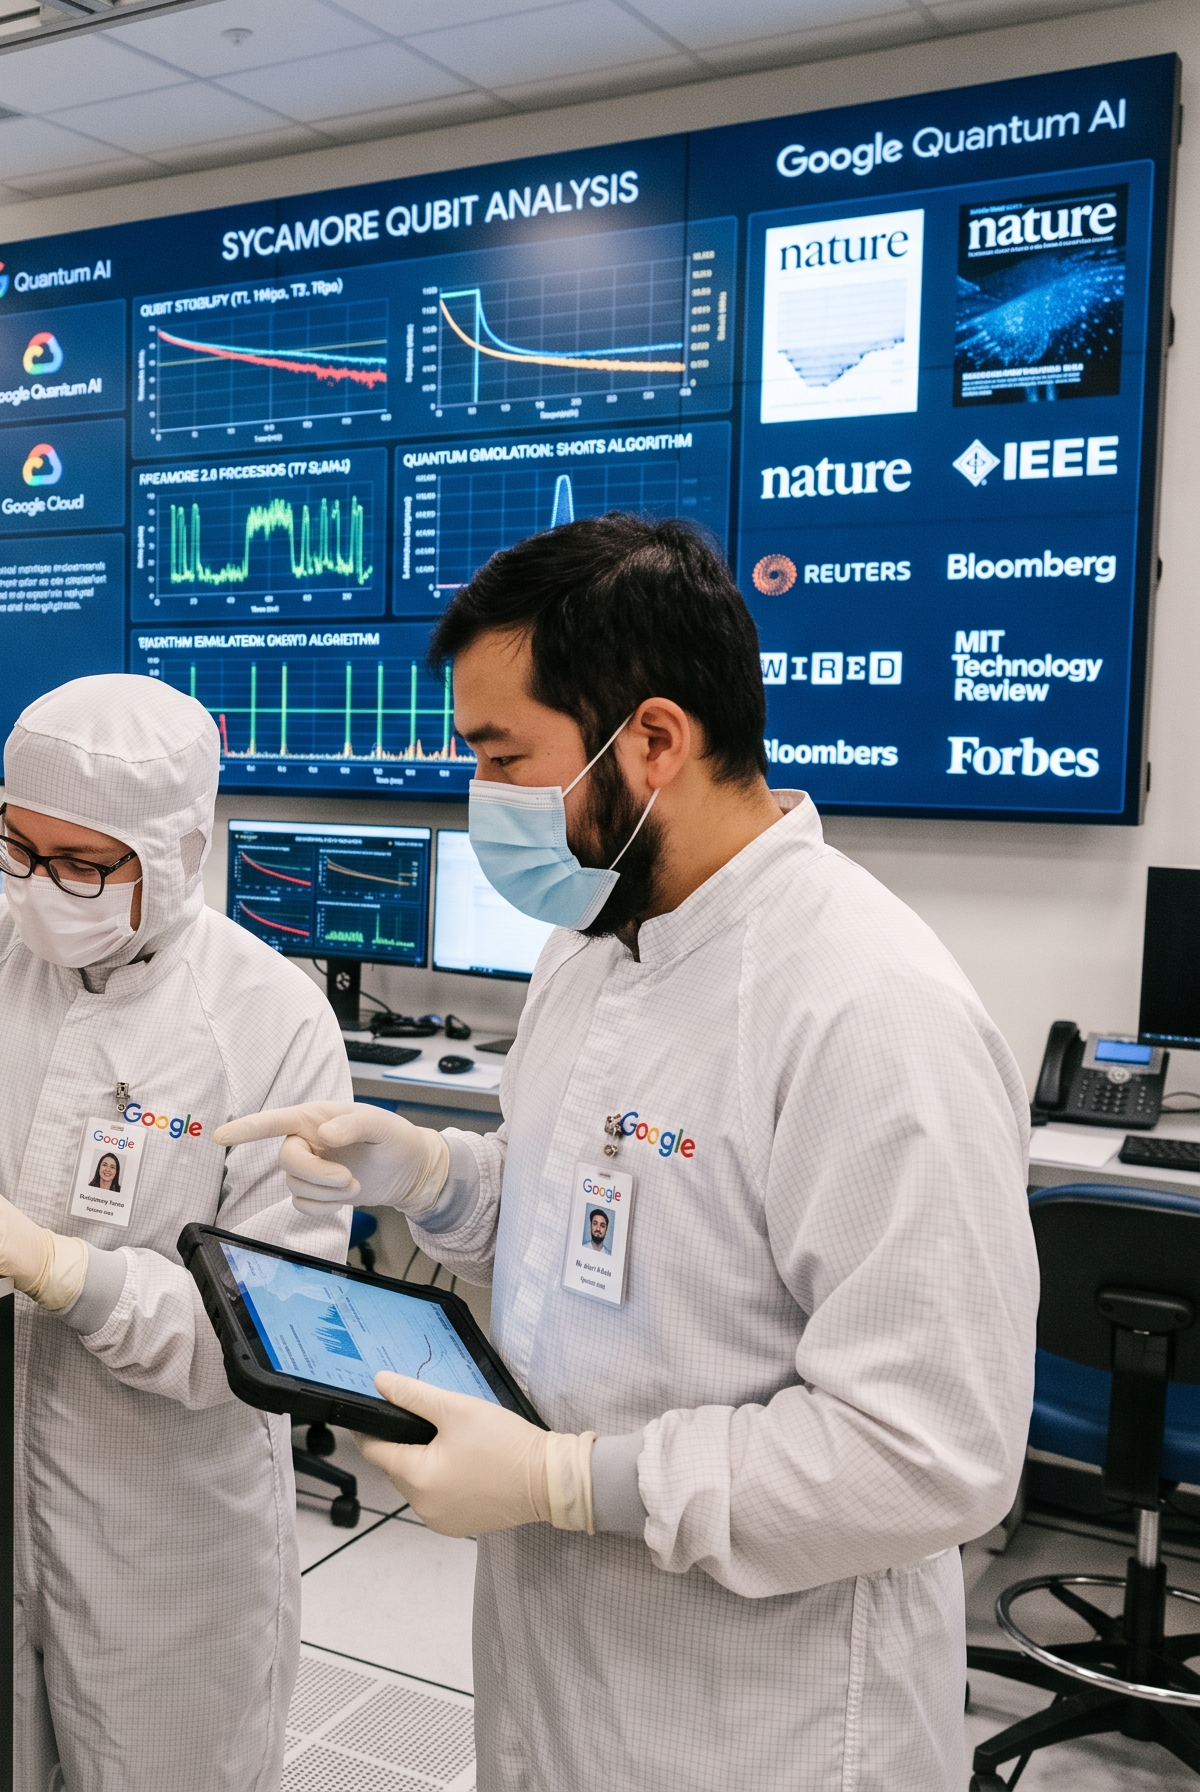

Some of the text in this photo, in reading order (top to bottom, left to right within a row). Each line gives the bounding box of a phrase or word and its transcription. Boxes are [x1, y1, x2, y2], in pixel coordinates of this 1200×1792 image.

[776, 98, 1126, 177] Google Quantum AI
[222, 170, 639, 260] SYCAMORE QUBIT ANALYSIS
[968, 203, 1117, 250] nature
[780, 230, 909, 271] nature
[14, 265, 90, 293] Quantum
[93, 260, 111, 280] AI
[31, 381, 85, 401] Quantum
[87, 378, 102, 395] AI
[403, 450, 467, 468] QUANTUM
[607, 433, 692, 453] ALGORITHM
[1004, 435, 1119, 481] IEEE
[760, 457, 912, 499] nature
[2, 494, 84, 517] Google Cloud
[804, 561, 911, 584] REUTERS
[947, 550, 1116, 583] Bloomberg
[954, 630, 1005, 653] MIT
[760, 651, 902, 685] WIRED
[952, 654, 1102, 682] Technology
[954, 678, 1049, 701] Review
[946, 736, 1099, 777] Forbes
[123, 1103, 202, 1139] Google
[620, 1111, 695, 1158] Google
[93, 1130, 135, 1149] Google
[582, 1178, 621, 1203] Google
